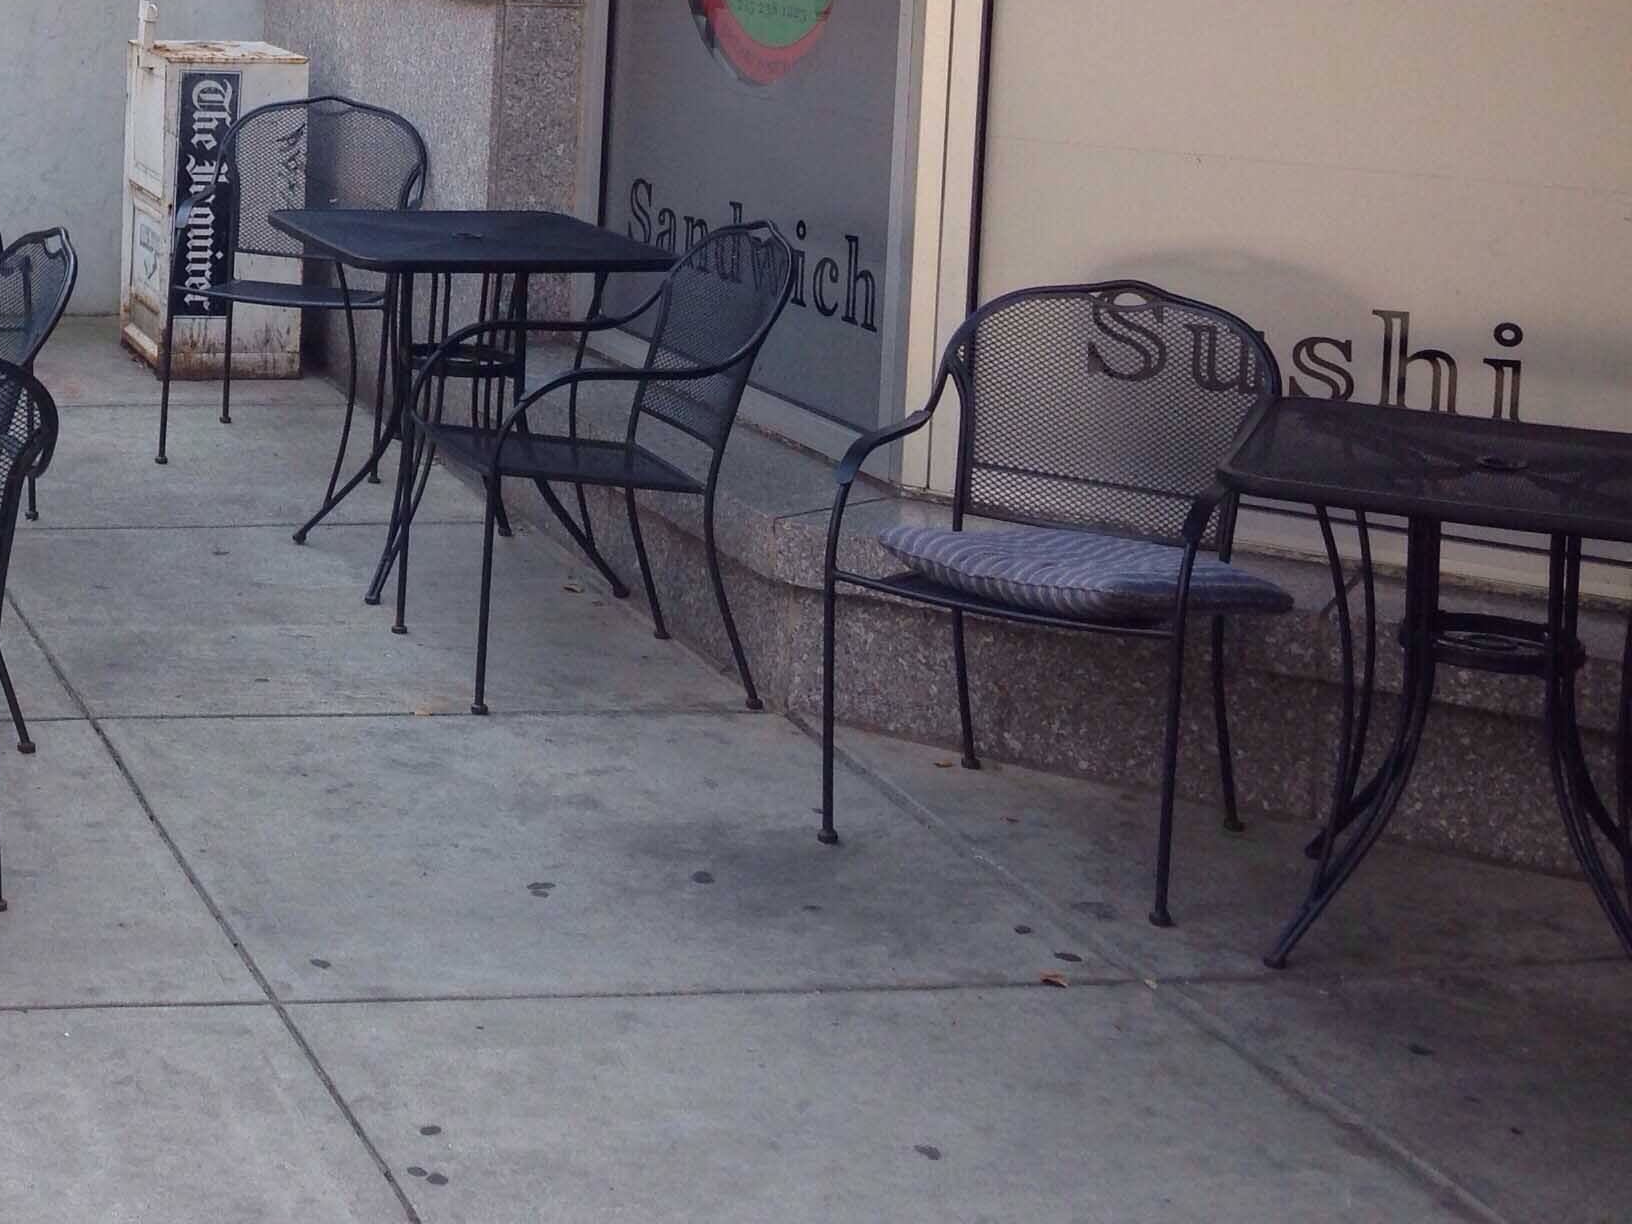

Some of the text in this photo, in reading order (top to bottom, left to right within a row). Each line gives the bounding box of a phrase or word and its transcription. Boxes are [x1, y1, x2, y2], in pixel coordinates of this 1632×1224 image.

[190, 78, 233, 152] The
[628, 178, 878, 333] Sandwich
[1087, 289, 1524, 422] Sushi
